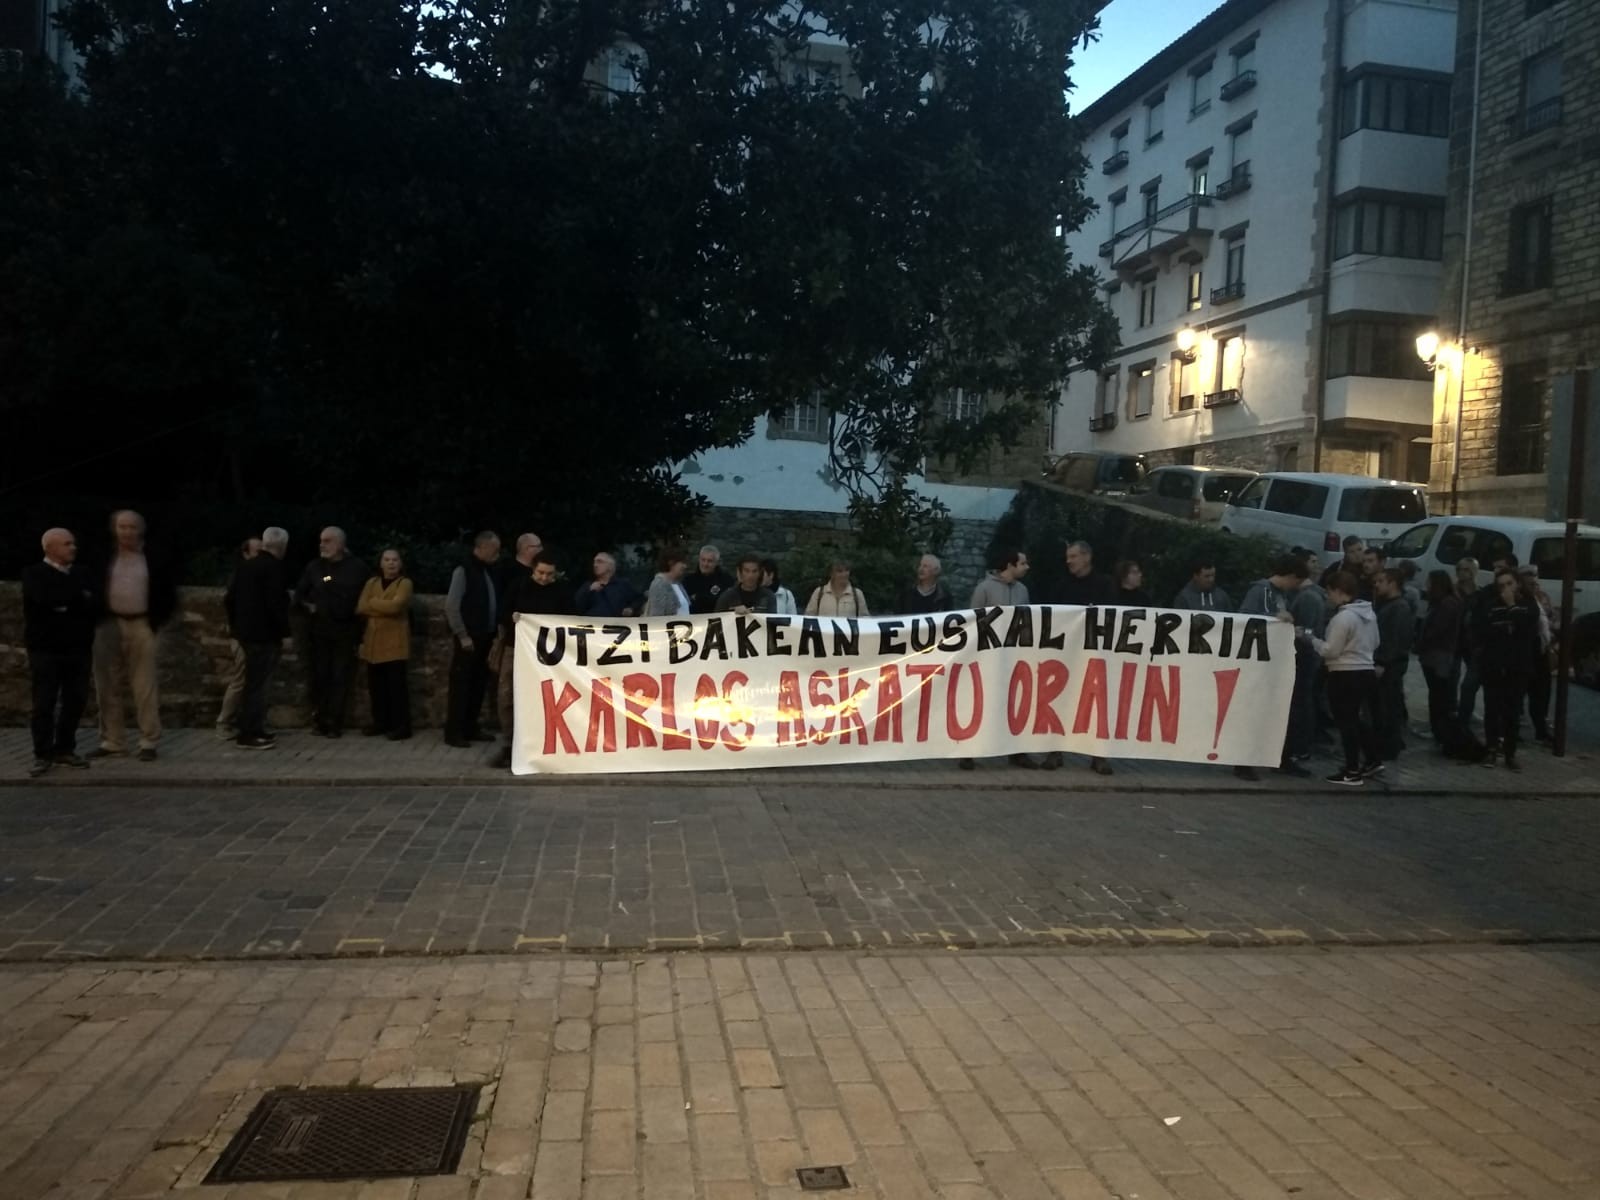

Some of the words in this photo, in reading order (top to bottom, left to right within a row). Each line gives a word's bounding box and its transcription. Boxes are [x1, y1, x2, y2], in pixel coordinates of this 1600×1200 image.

[536, 624, 650, 667] UTZI
[667, 616, 859, 665] BAKEAN
[878, 606, 1065, 656] EUSKAL
[1083, 607, 1271, 661] HERRIA
[541, 670, 755, 755] KARLOS
[776, 660, 984, 748] ASKATU
[1007, 658, 1181, 745] ORAIN
